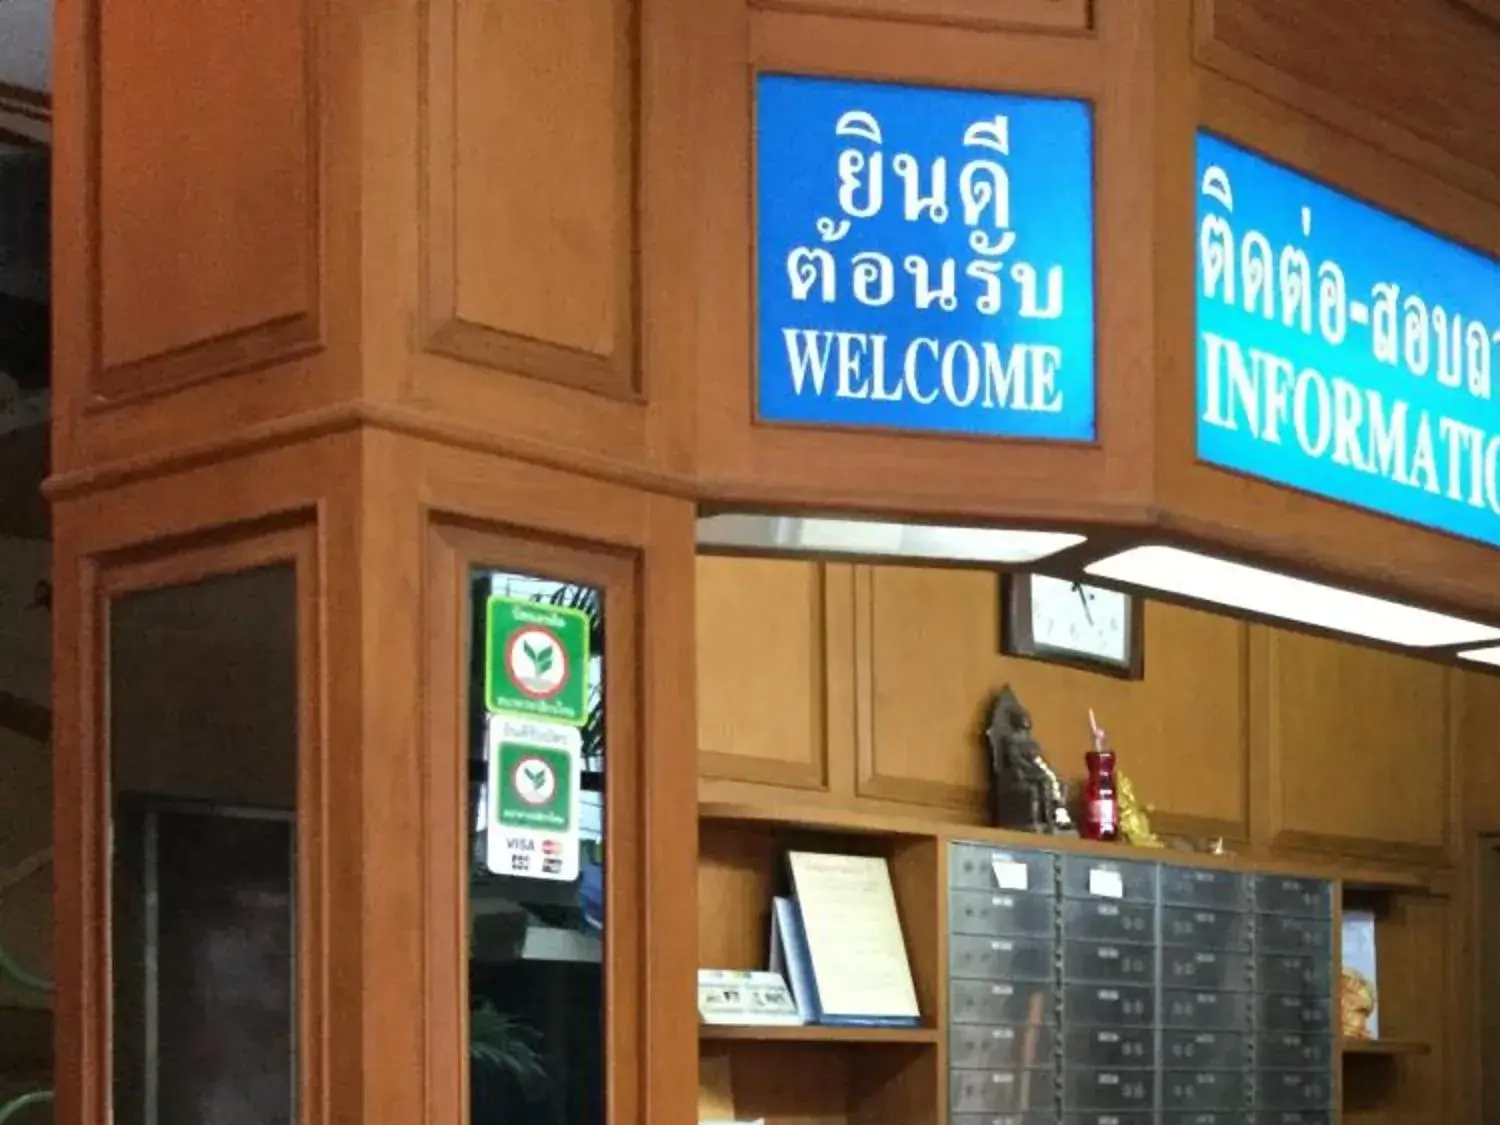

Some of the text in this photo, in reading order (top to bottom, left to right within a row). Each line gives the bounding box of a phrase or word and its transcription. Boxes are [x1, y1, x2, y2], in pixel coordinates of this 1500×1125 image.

[835, 110, 1010, 228] ยินดี
[786, 216, 1064, 319] ต้อนรับ
[781, 327, 1063, 413] WELCOME
[506, 837, 535, 851] VISA
